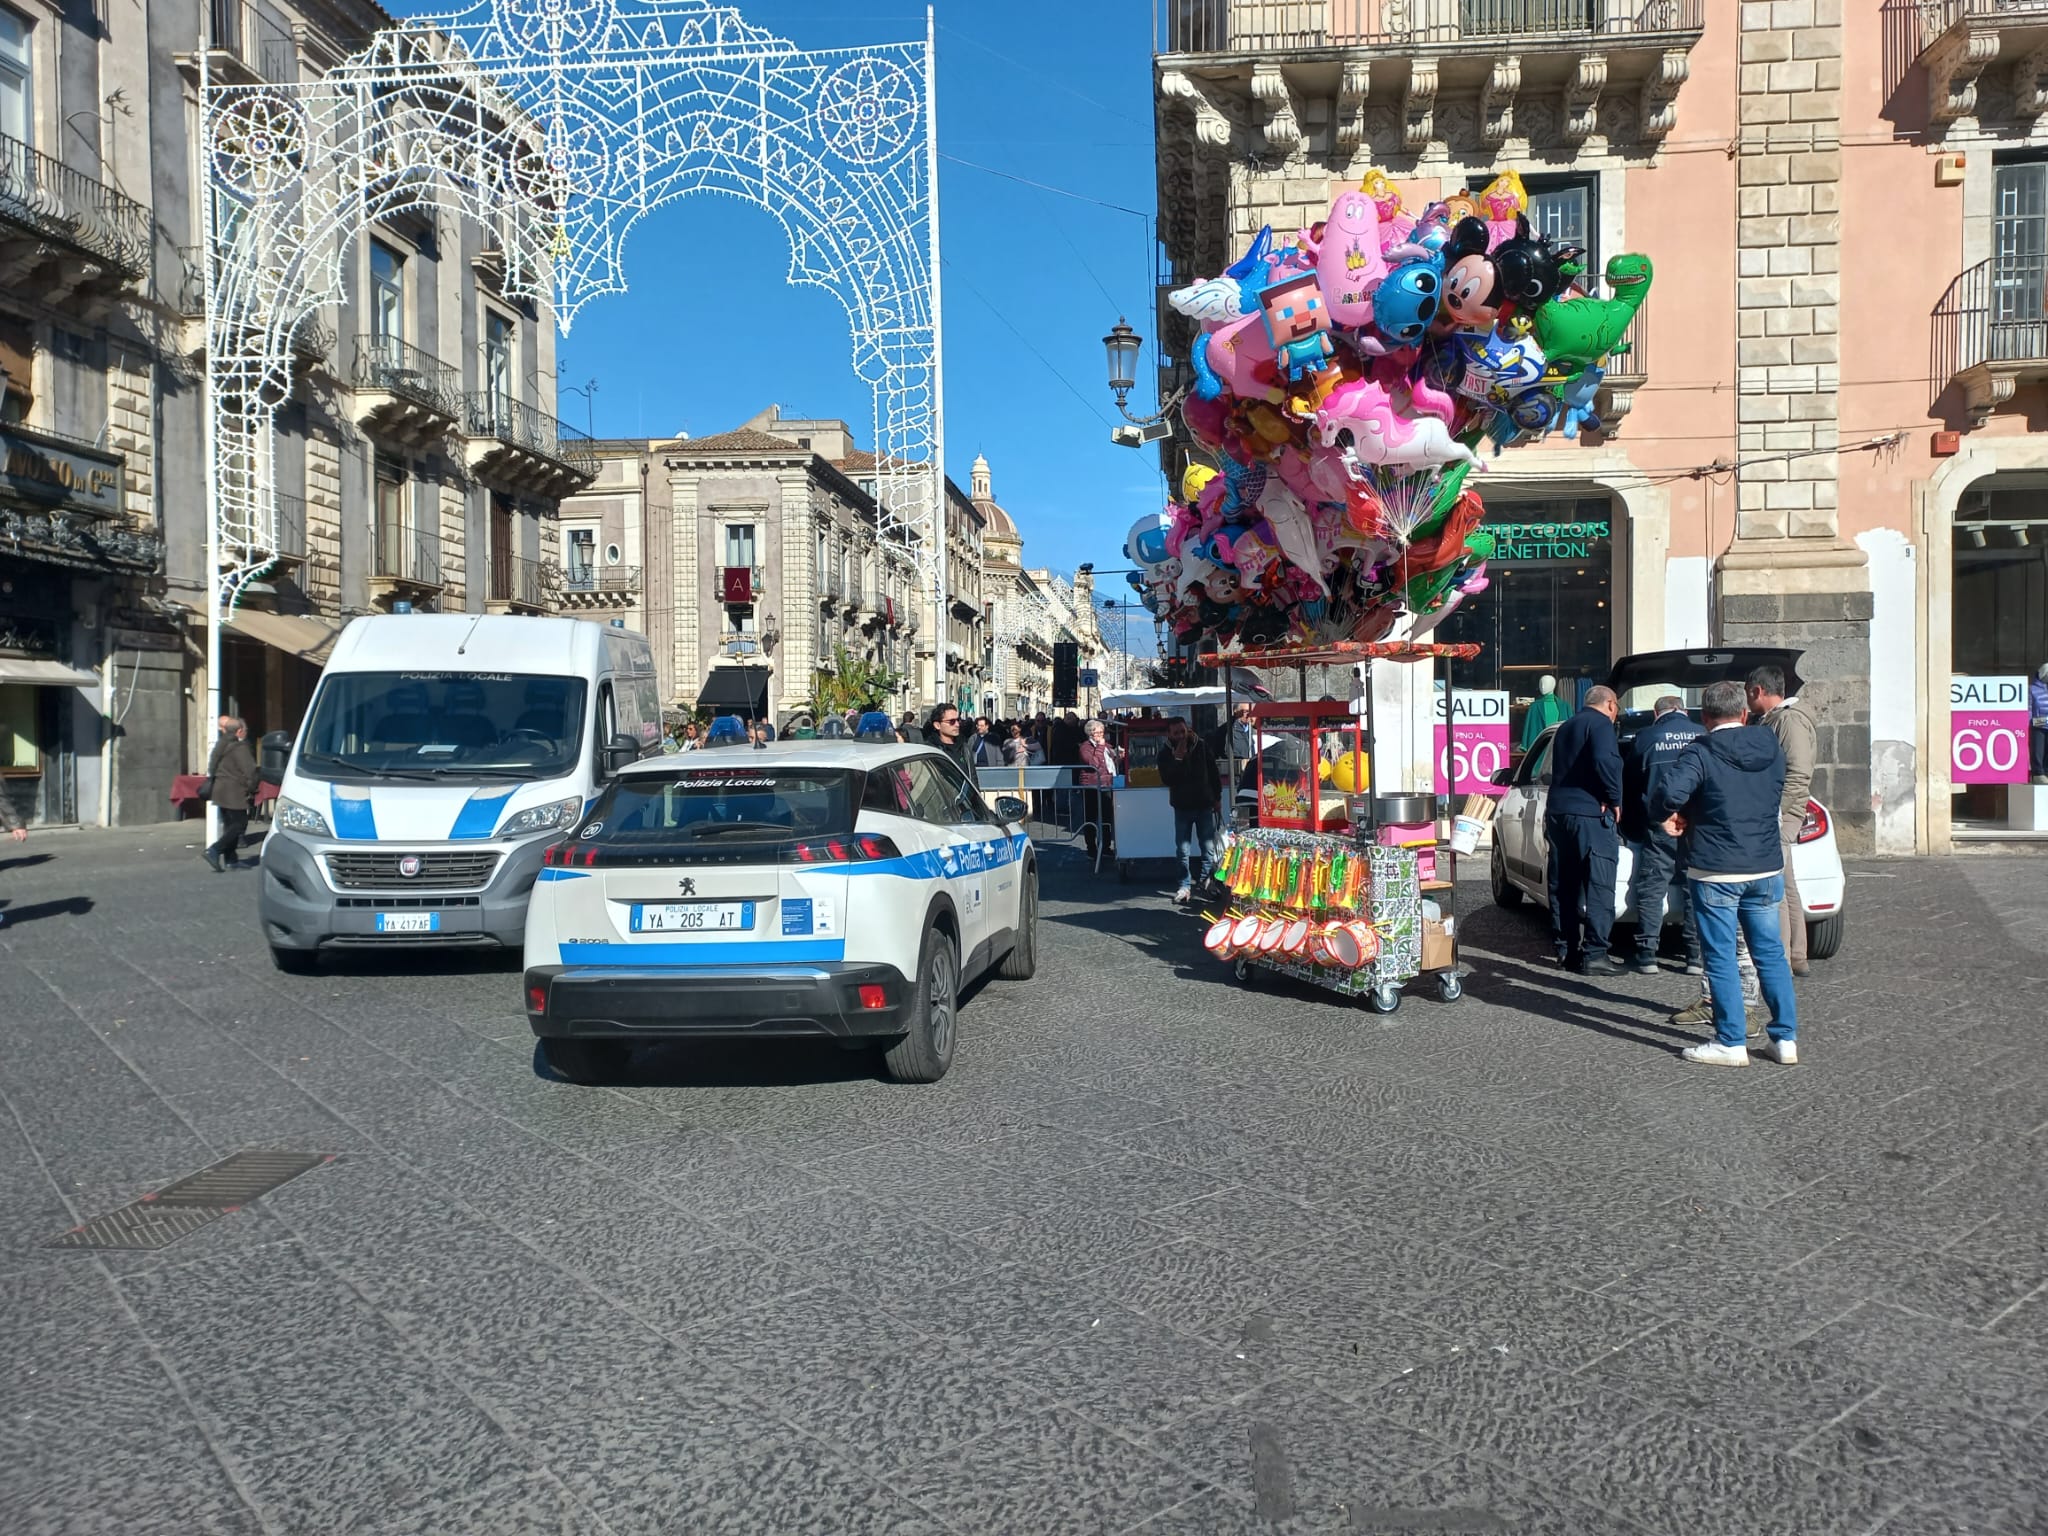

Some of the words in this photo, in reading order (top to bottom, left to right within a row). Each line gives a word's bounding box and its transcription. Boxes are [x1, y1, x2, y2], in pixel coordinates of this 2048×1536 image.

[1333, 288, 1372, 304] BARBAPA
[1465, 373, 1487, 393] FAST
[1474, 522, 1525, 539] ITED
[1530, 521, 1609, 539] COLORS
[731, 577, 744, 592] A
[400, 671, 453, 680] POLIZIA
[460, 672, 512, 682] LOCALE
[1951, 683, 2022, 703] SALDI
[1436, 698, 1504, 717] SALDI
[1968, 719, 1988, 727] FINO
[1990, 719, 2000, 727] AL
[1455, 732, 1474, 740] FINO
[1475, 732, 1485, 740] AL
[1665, 731, 1697, 741] Polizi
[673, 779, 722, 789] Polizia
[724, 778, 776, 787] Locale
[585, 825, 599, 834] 20
[403, 862, 416, 874] FIAT
[693, 904, 719, 912] LOCALE
[649, 914, 664, 928] YA
[719, 911, 735, 927] AT
